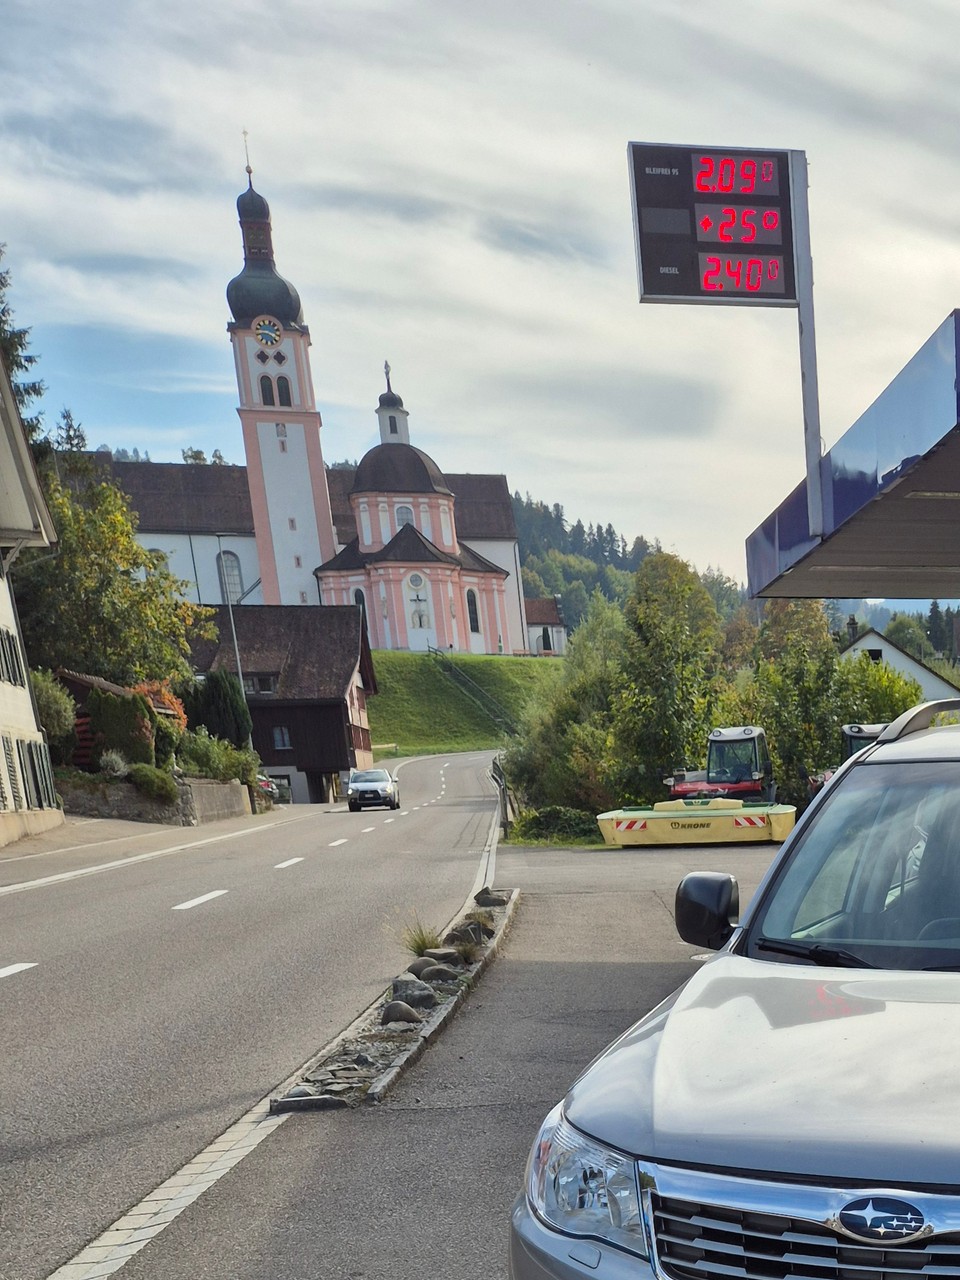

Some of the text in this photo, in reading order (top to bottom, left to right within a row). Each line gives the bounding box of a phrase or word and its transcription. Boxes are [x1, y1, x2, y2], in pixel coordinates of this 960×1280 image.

[671, 168, 679, 176] 95
[659, 266, 679, 275] DIESEL
[680, 822, 711, 830] KRONE
